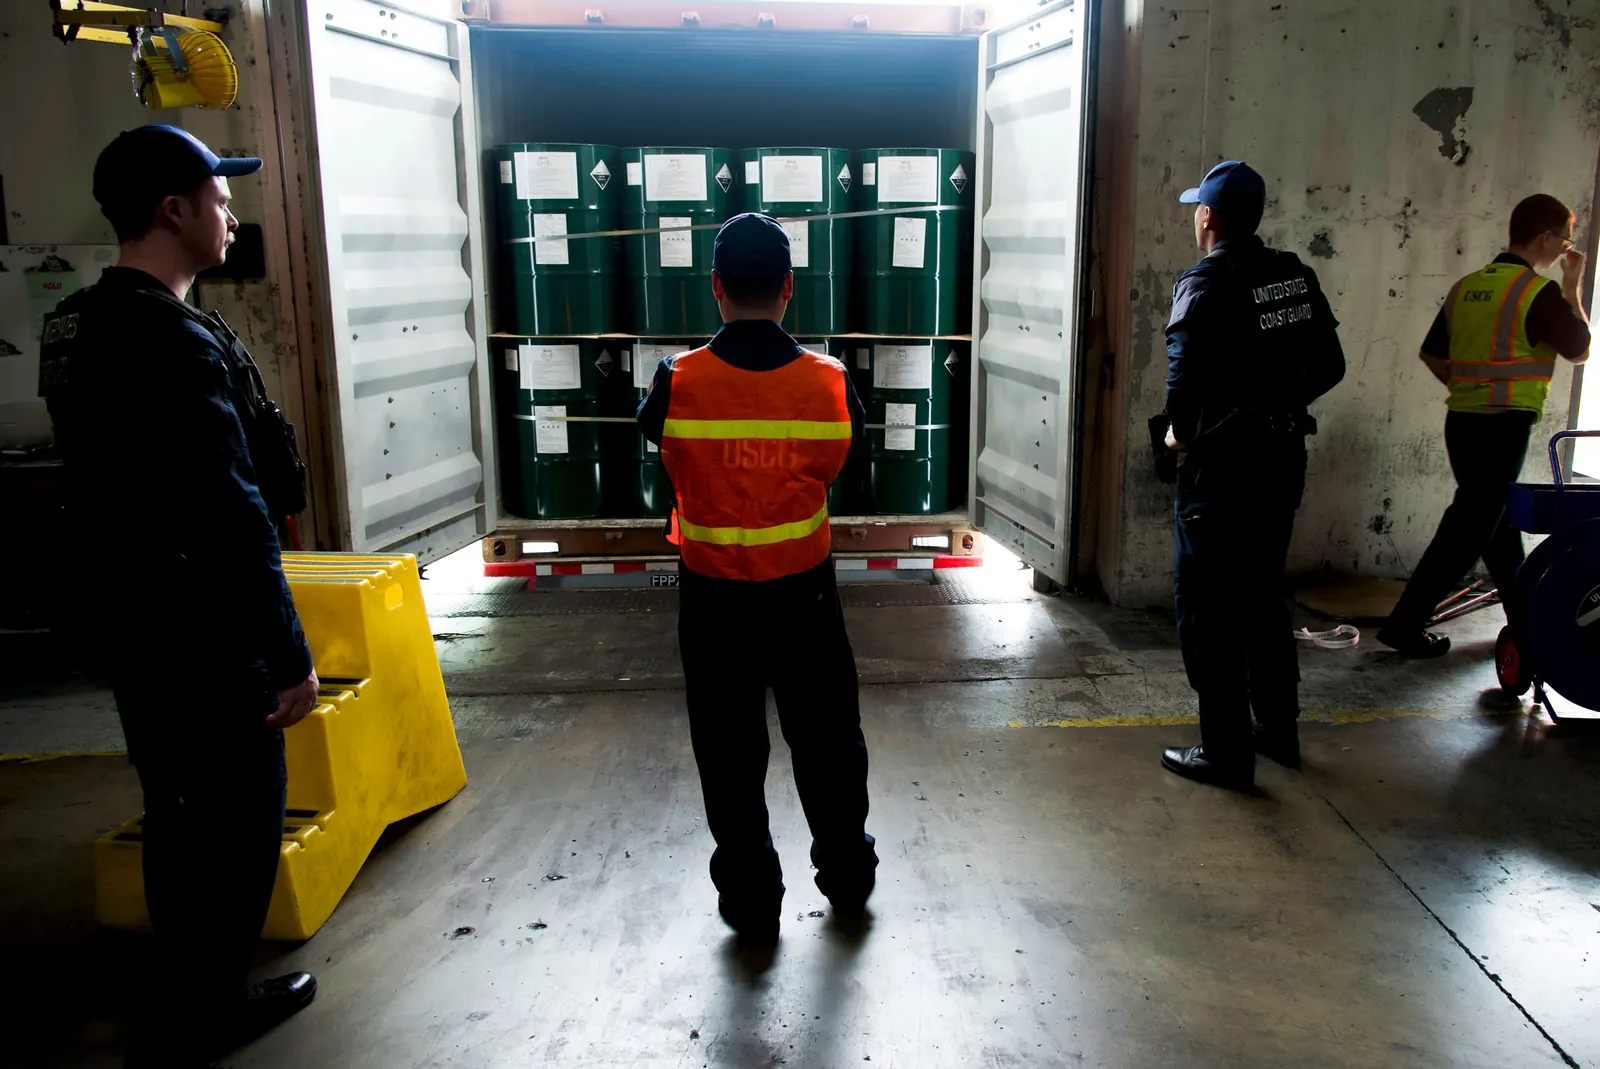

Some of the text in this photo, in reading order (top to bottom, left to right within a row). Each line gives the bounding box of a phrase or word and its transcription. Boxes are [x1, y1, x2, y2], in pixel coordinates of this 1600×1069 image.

[1252, 278, 1308, 304] UNITED STATES
[1463, 290, 1494, 302] USCG
[1260, 303, 1312, 330] COAST GUARD
[723, 438, 798, 469] USCG
